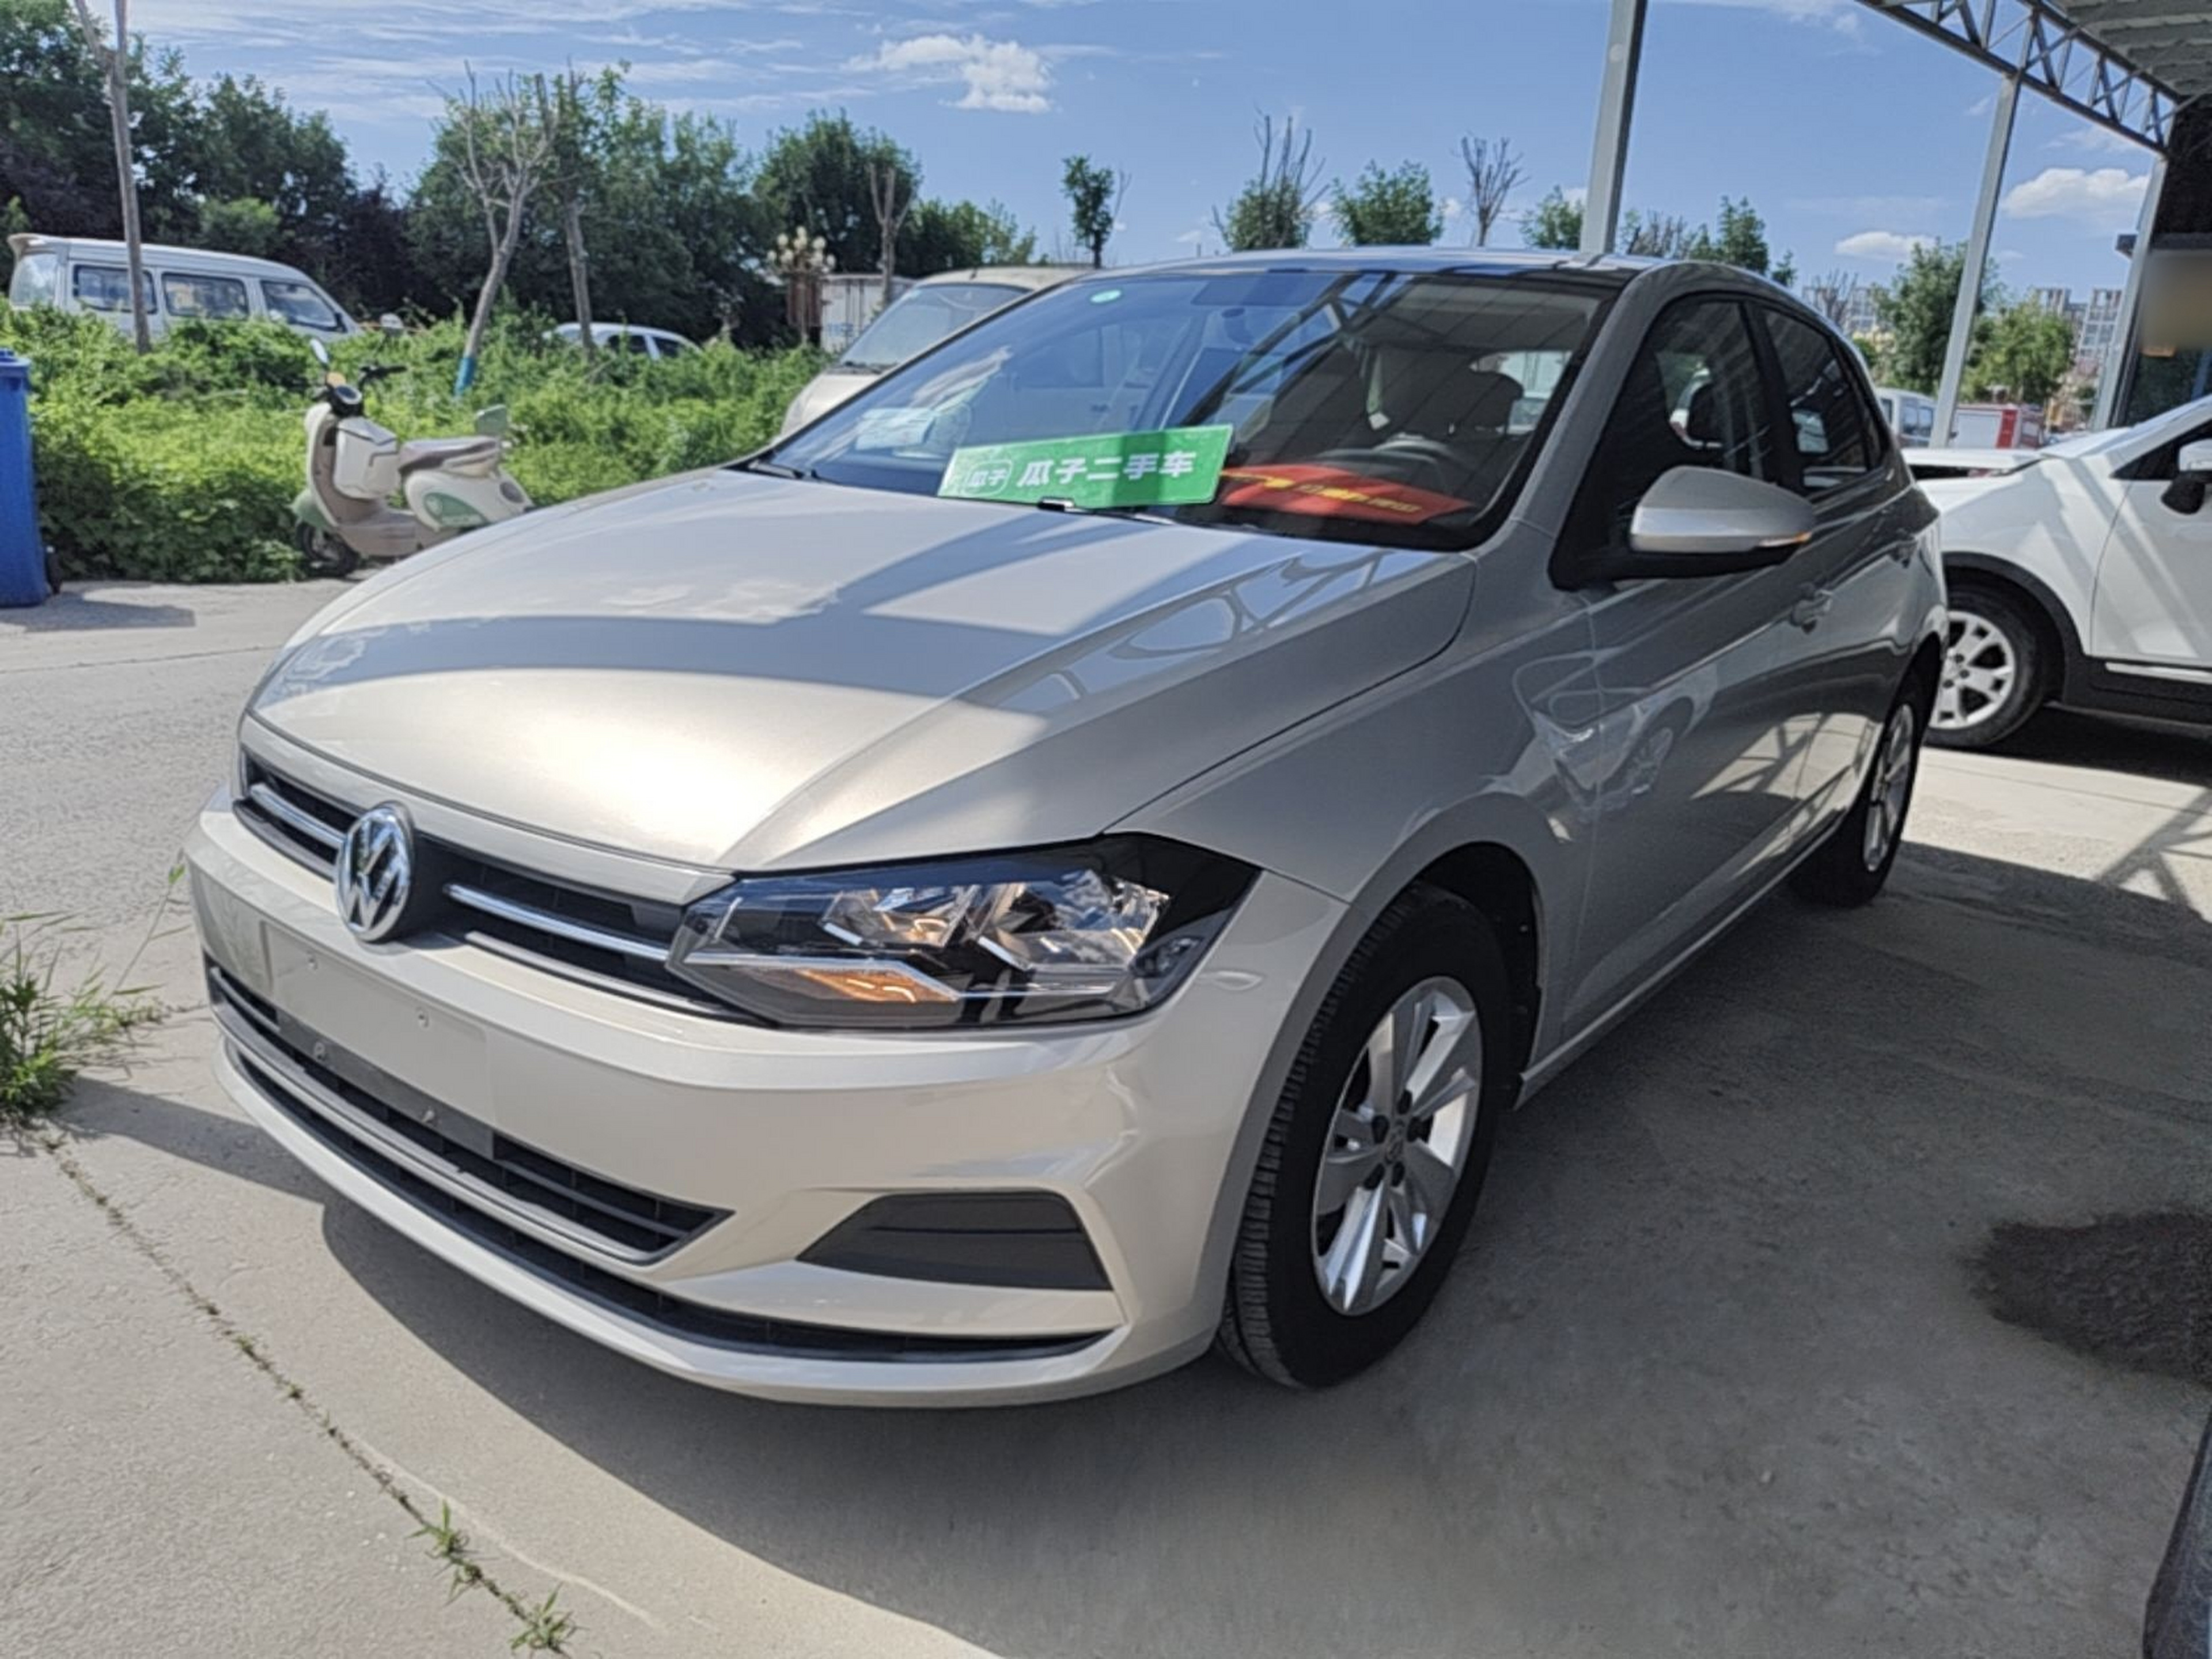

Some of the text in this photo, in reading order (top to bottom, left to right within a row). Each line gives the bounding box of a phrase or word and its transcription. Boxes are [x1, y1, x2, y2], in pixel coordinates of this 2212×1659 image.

[1017, 450, 1196, 487] 瓜子二手车
[342, 810, 410, 937] VW
